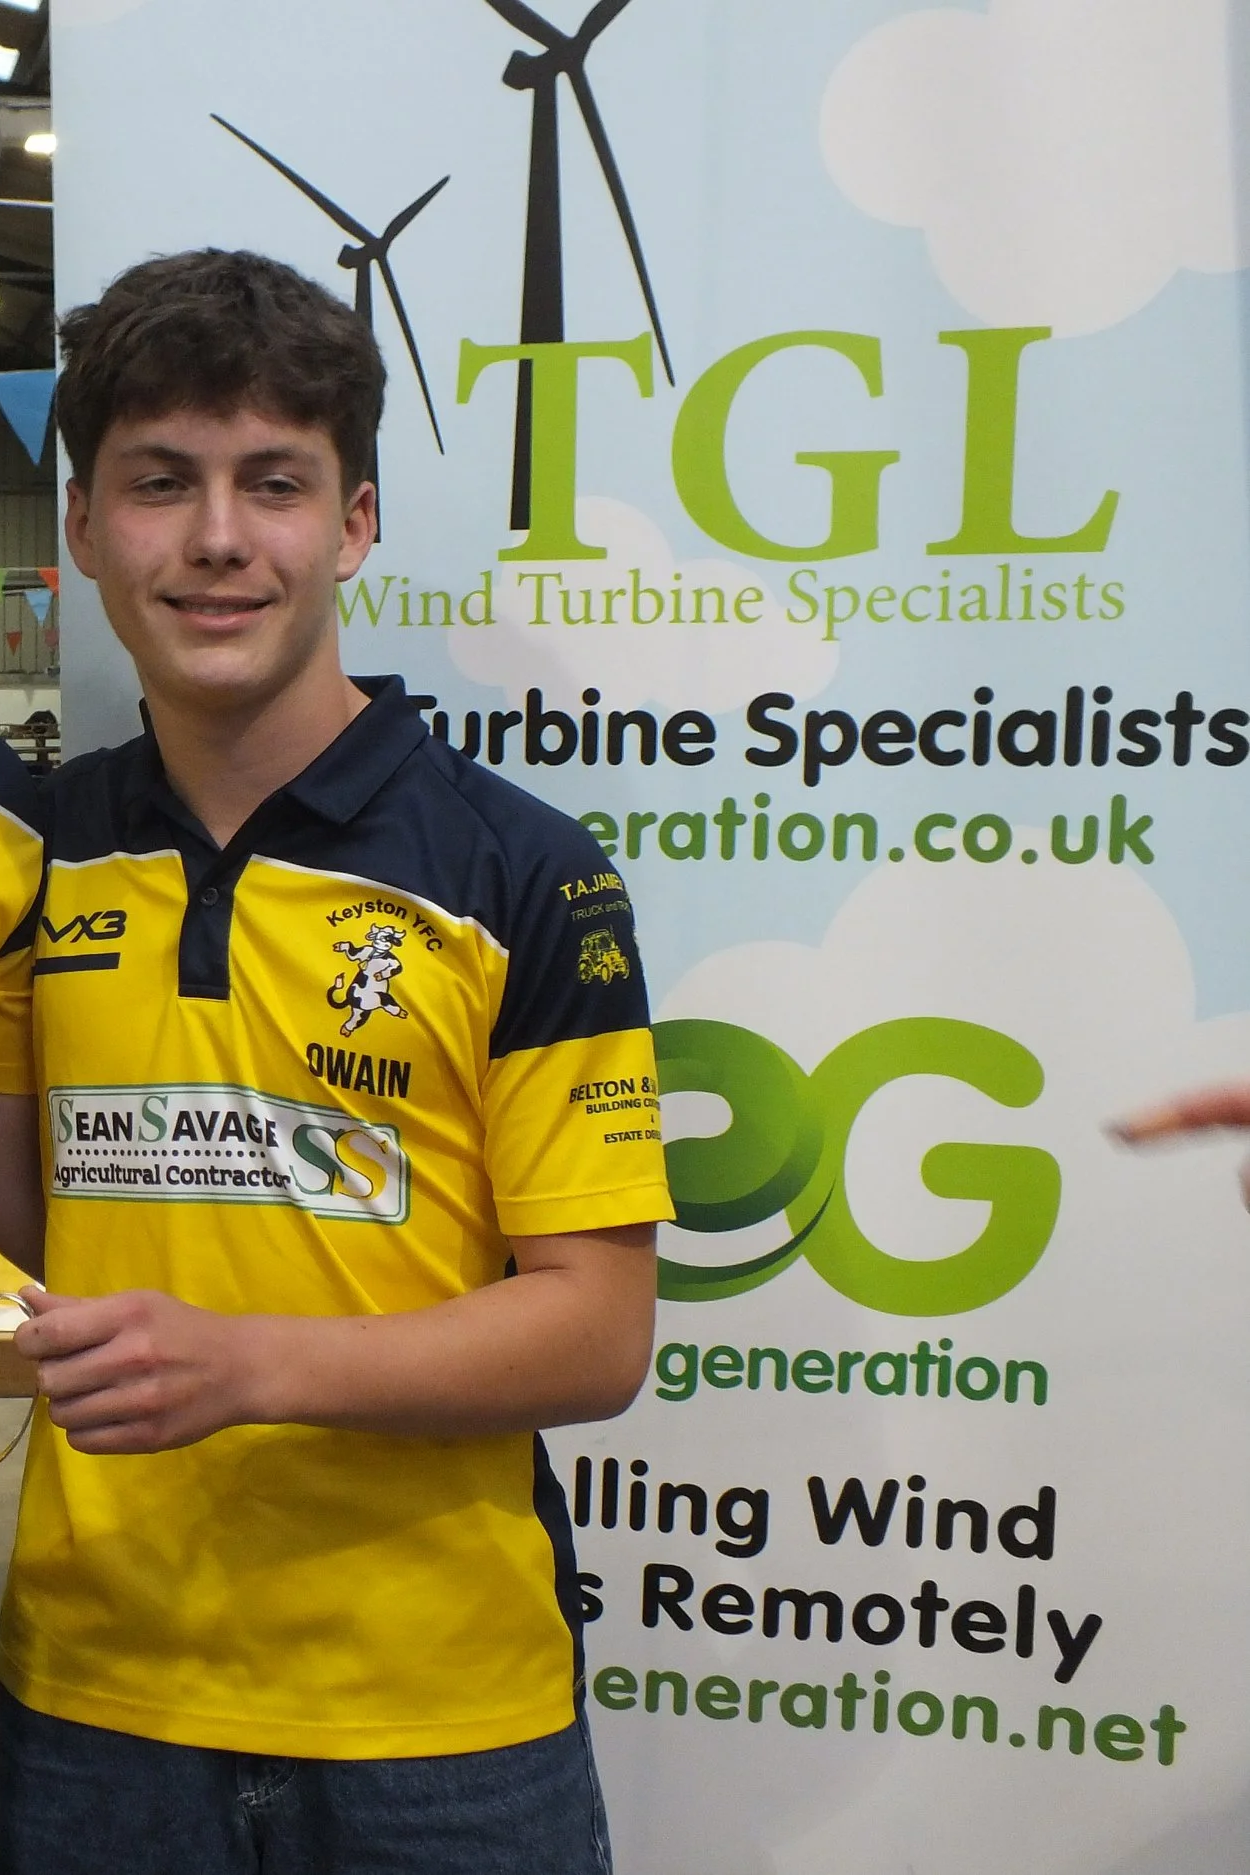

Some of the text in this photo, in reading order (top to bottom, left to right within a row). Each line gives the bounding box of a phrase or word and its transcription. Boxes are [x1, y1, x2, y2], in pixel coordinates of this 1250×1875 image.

[456, 326, 1120, 562] TGL
[335, 562, 1126, 640] Wind Turbine Specialists
[745, 685, 1250, 787] Specialists
[41, 909, 127, 943] VX3
[326, 899, 443, 952] Keyston YFC
[570, 903, 605, 921] TRUCK
[306, 1042, 411, 1098] OWAIN
[569, 1078, 635, 1104] BELTON
[641, 1076, 650, 1093] &
[57, 1095, 279, 1148] SEAN SAVAGE
[586, 1098, 642, 1114] BUILDING
[604, 1130, 643, 1144] ESTATE
[54, 1161, 291, 1190] Agricultural Contractor
[655, 1337, 1049, 1406] generation
[574, 1456, 1057, 1561] lling Wind
[641, 1562, 1103, 1684] Remotely
[593, 1664, 1187, 1766] eneration.net
